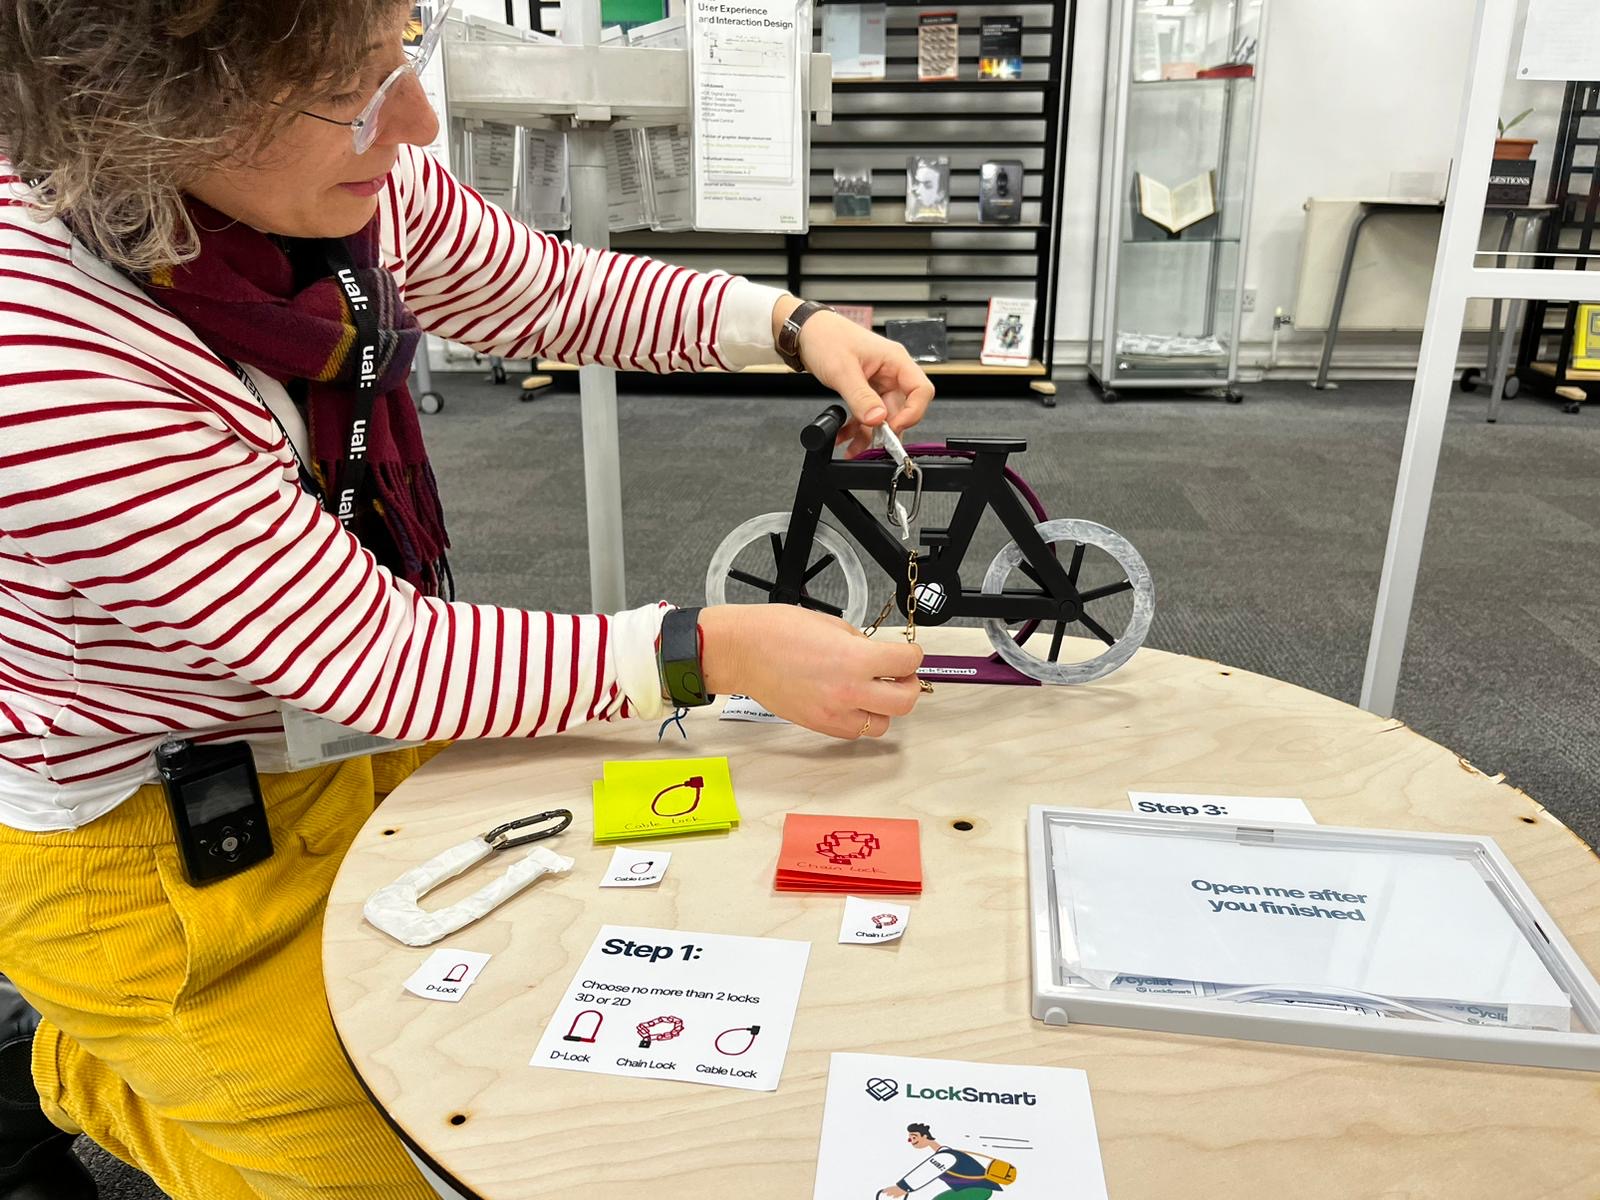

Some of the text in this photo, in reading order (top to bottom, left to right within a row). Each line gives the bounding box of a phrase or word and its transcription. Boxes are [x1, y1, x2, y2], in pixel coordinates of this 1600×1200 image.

[720, 5, 768, 15] Experience
[716, 17, 762, 27] Interaction
[764, 19, 793, 30] Design
[337, 268, 369, 312] ual:
[360, 345, 377, 389] ual:
[349, 419, 367, 461] ual:
[1138, 801, 1229, 816] Step 3:
[796, 862, 843, 871] Chain
[1191, 879, 1368, 904] Open me after
[1207, 899, 1366, 921] you finished
[601, 938, 704, 963] Step 1:
[1125, 976, 1174, 987] Cyclist
[425, 984, 459, 995] D-Lock
[581, 980, 760, 1005] Choose no more than 2 locks
[575, 993, 632, 1008] 3D or 2D
[549, 1050, 591, 1064] D-Lock
[616, 1057, 677, 1072] Chain Lock
[695, 1064, 758, 1079] Cable Lock
[906, 1083, 1037, 1106] LockSmart
